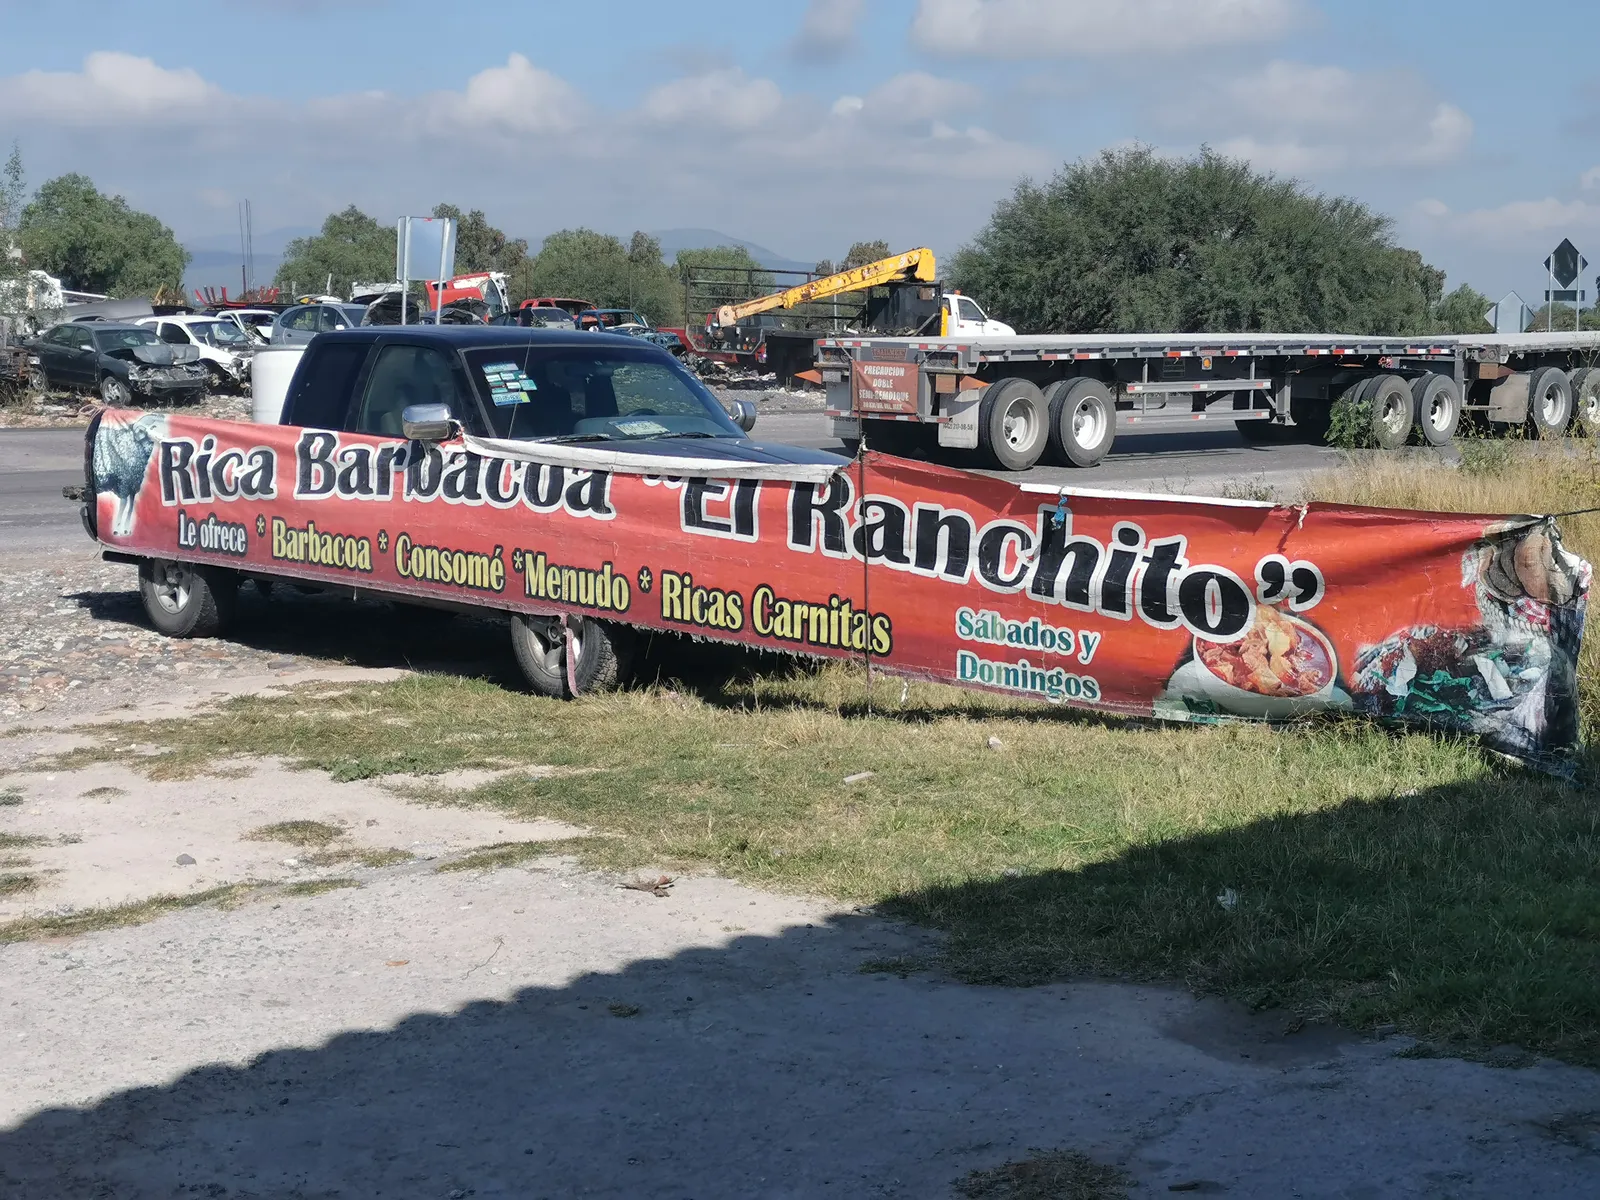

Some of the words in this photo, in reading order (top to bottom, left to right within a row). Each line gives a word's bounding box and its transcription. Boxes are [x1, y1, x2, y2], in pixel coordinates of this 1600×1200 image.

[864, 365, 905, 377] PRECAUCION
[872, 378, 894, 388] DOBLE
[159, 436, 275, 504] Rica
[295, 430, 615, 518] Barbacoa
[179, 512, 197, 548] Le
[200, 516, 247, 553] ofrece
[271, 518, 373, 571] Barbacoa
[395, 534, 505, 591] Consomé
[661, 572, 744, 630] Ricas
[752, 586, 892, 654] Carnitas
[958, 608, 1074, 653] Sábados
[1081, 632, 1100, 663] y
[958, 652, 1100, 701] Domingos
